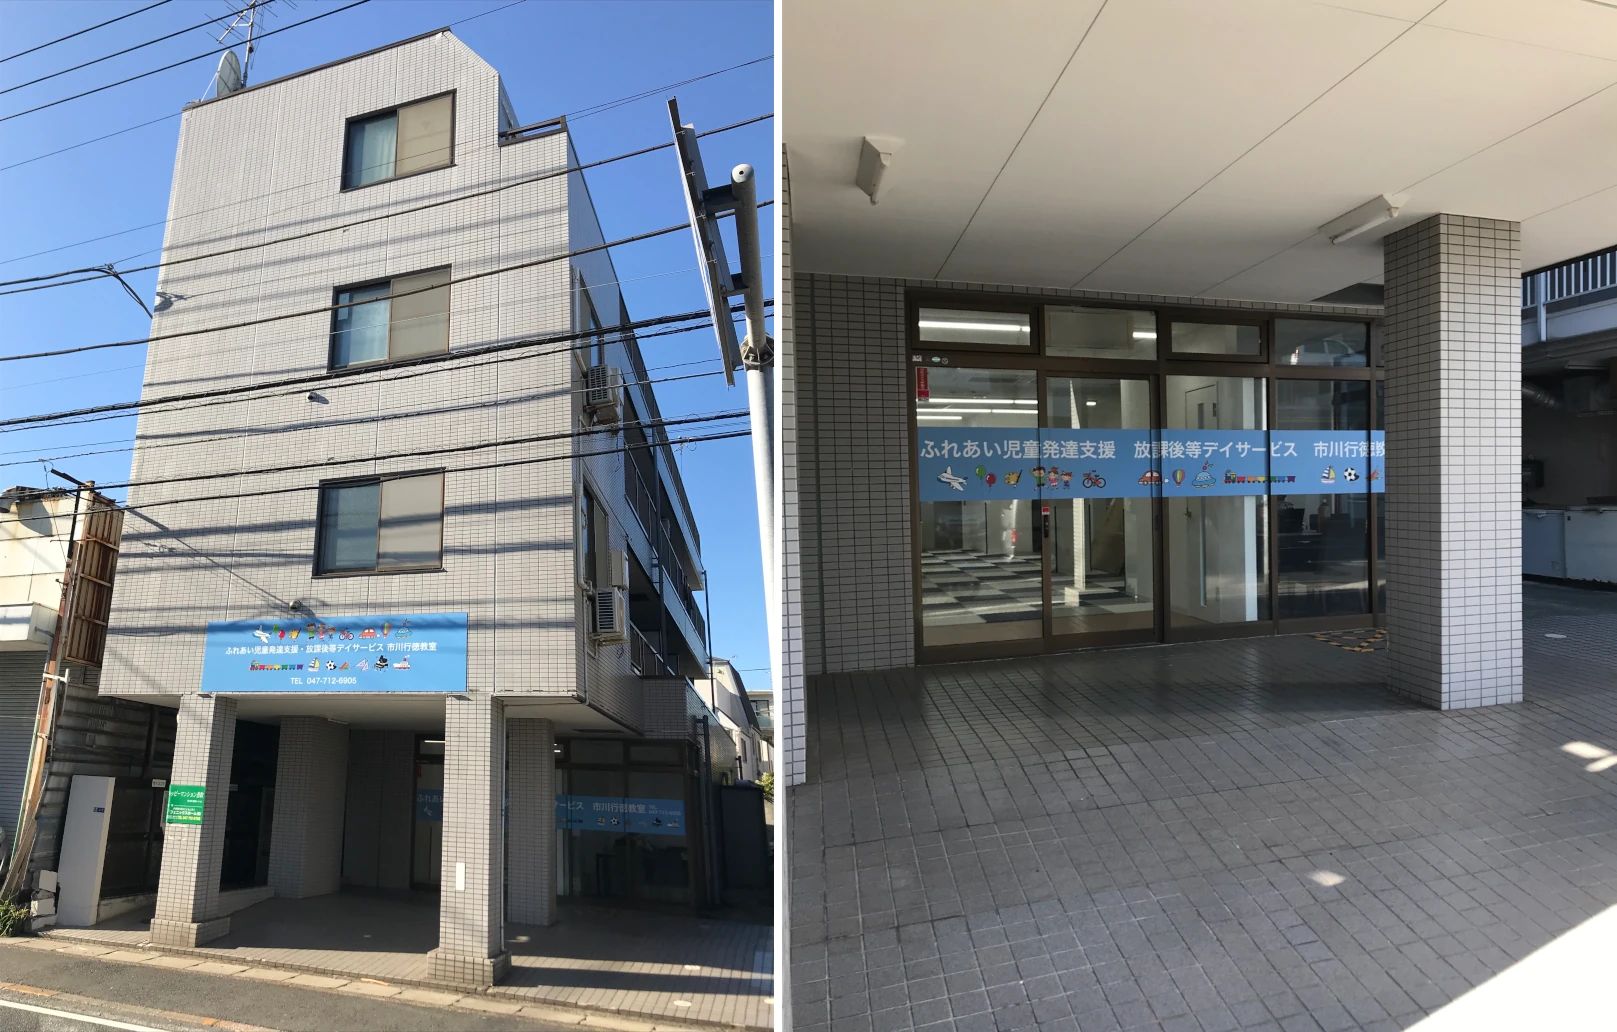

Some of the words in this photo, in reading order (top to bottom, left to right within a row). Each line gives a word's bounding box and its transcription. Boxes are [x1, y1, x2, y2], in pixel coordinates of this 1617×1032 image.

[920, 440, 1116, 459] ふれあい児童発達支援
[1134, 440, 1298, 459] 放課後等デイサービス
[387, 642, 437, 652] 市川行徳教室
[291, 677, 303, 685] TEL
[306, 677, 357, 685] 047-712-6905
